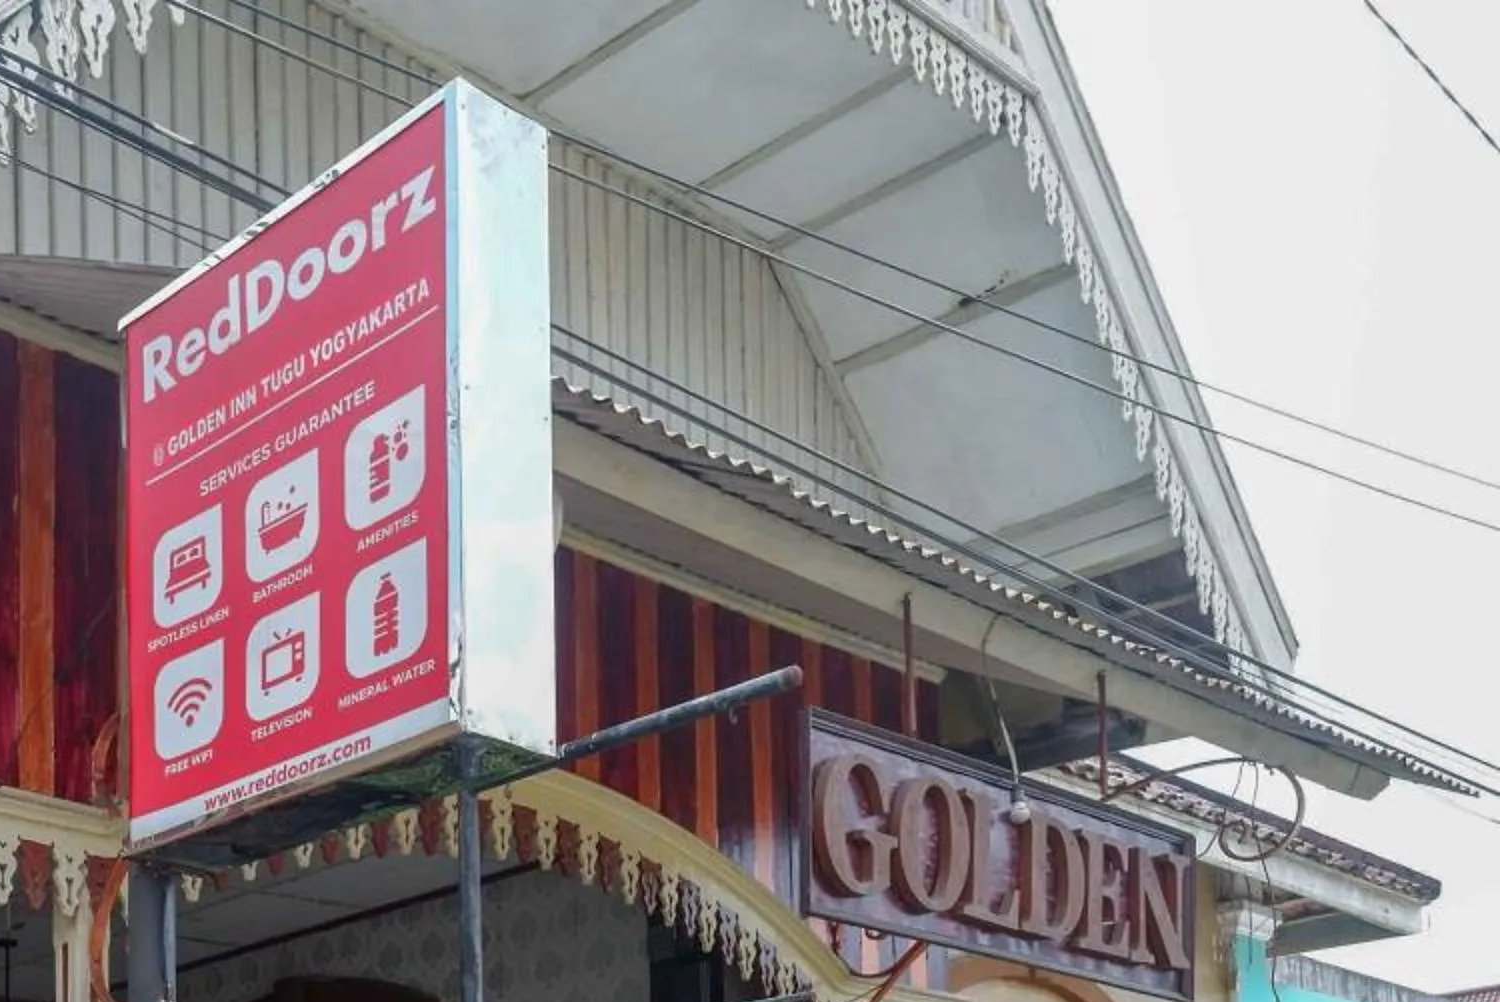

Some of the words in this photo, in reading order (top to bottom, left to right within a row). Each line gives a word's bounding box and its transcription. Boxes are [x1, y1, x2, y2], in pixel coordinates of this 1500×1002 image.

[141, 165, 437, 402] RedDoorz
[167, 404, 227, 457] GOLDEN
[230, 385, 258, 419] INN
[260, 353, 305, 398] TUGU
[309, 277, 431, 368] YOGYAKARTA
[200, 442, 272, 497] SERVICES
[275, 379, 376, 452] GUARANTEE
[356, 509, 420, 553] AMENITIES
[252, 562, 314, 604] BATHROOM
[147, 620, 199, 654] SPOTLESS
[199, 605, 230, 630] LINEN
[338, 679, 389, 711] MINERAL
[391, 657, 437, 688] WATER
[250, 707, 314, 742] TELEVISION
[164, 757, 190, 779] FREE
[203, 734, 372, 812] www.reddoorz.com
[813, 753, 1191, 970] GOLDEN
